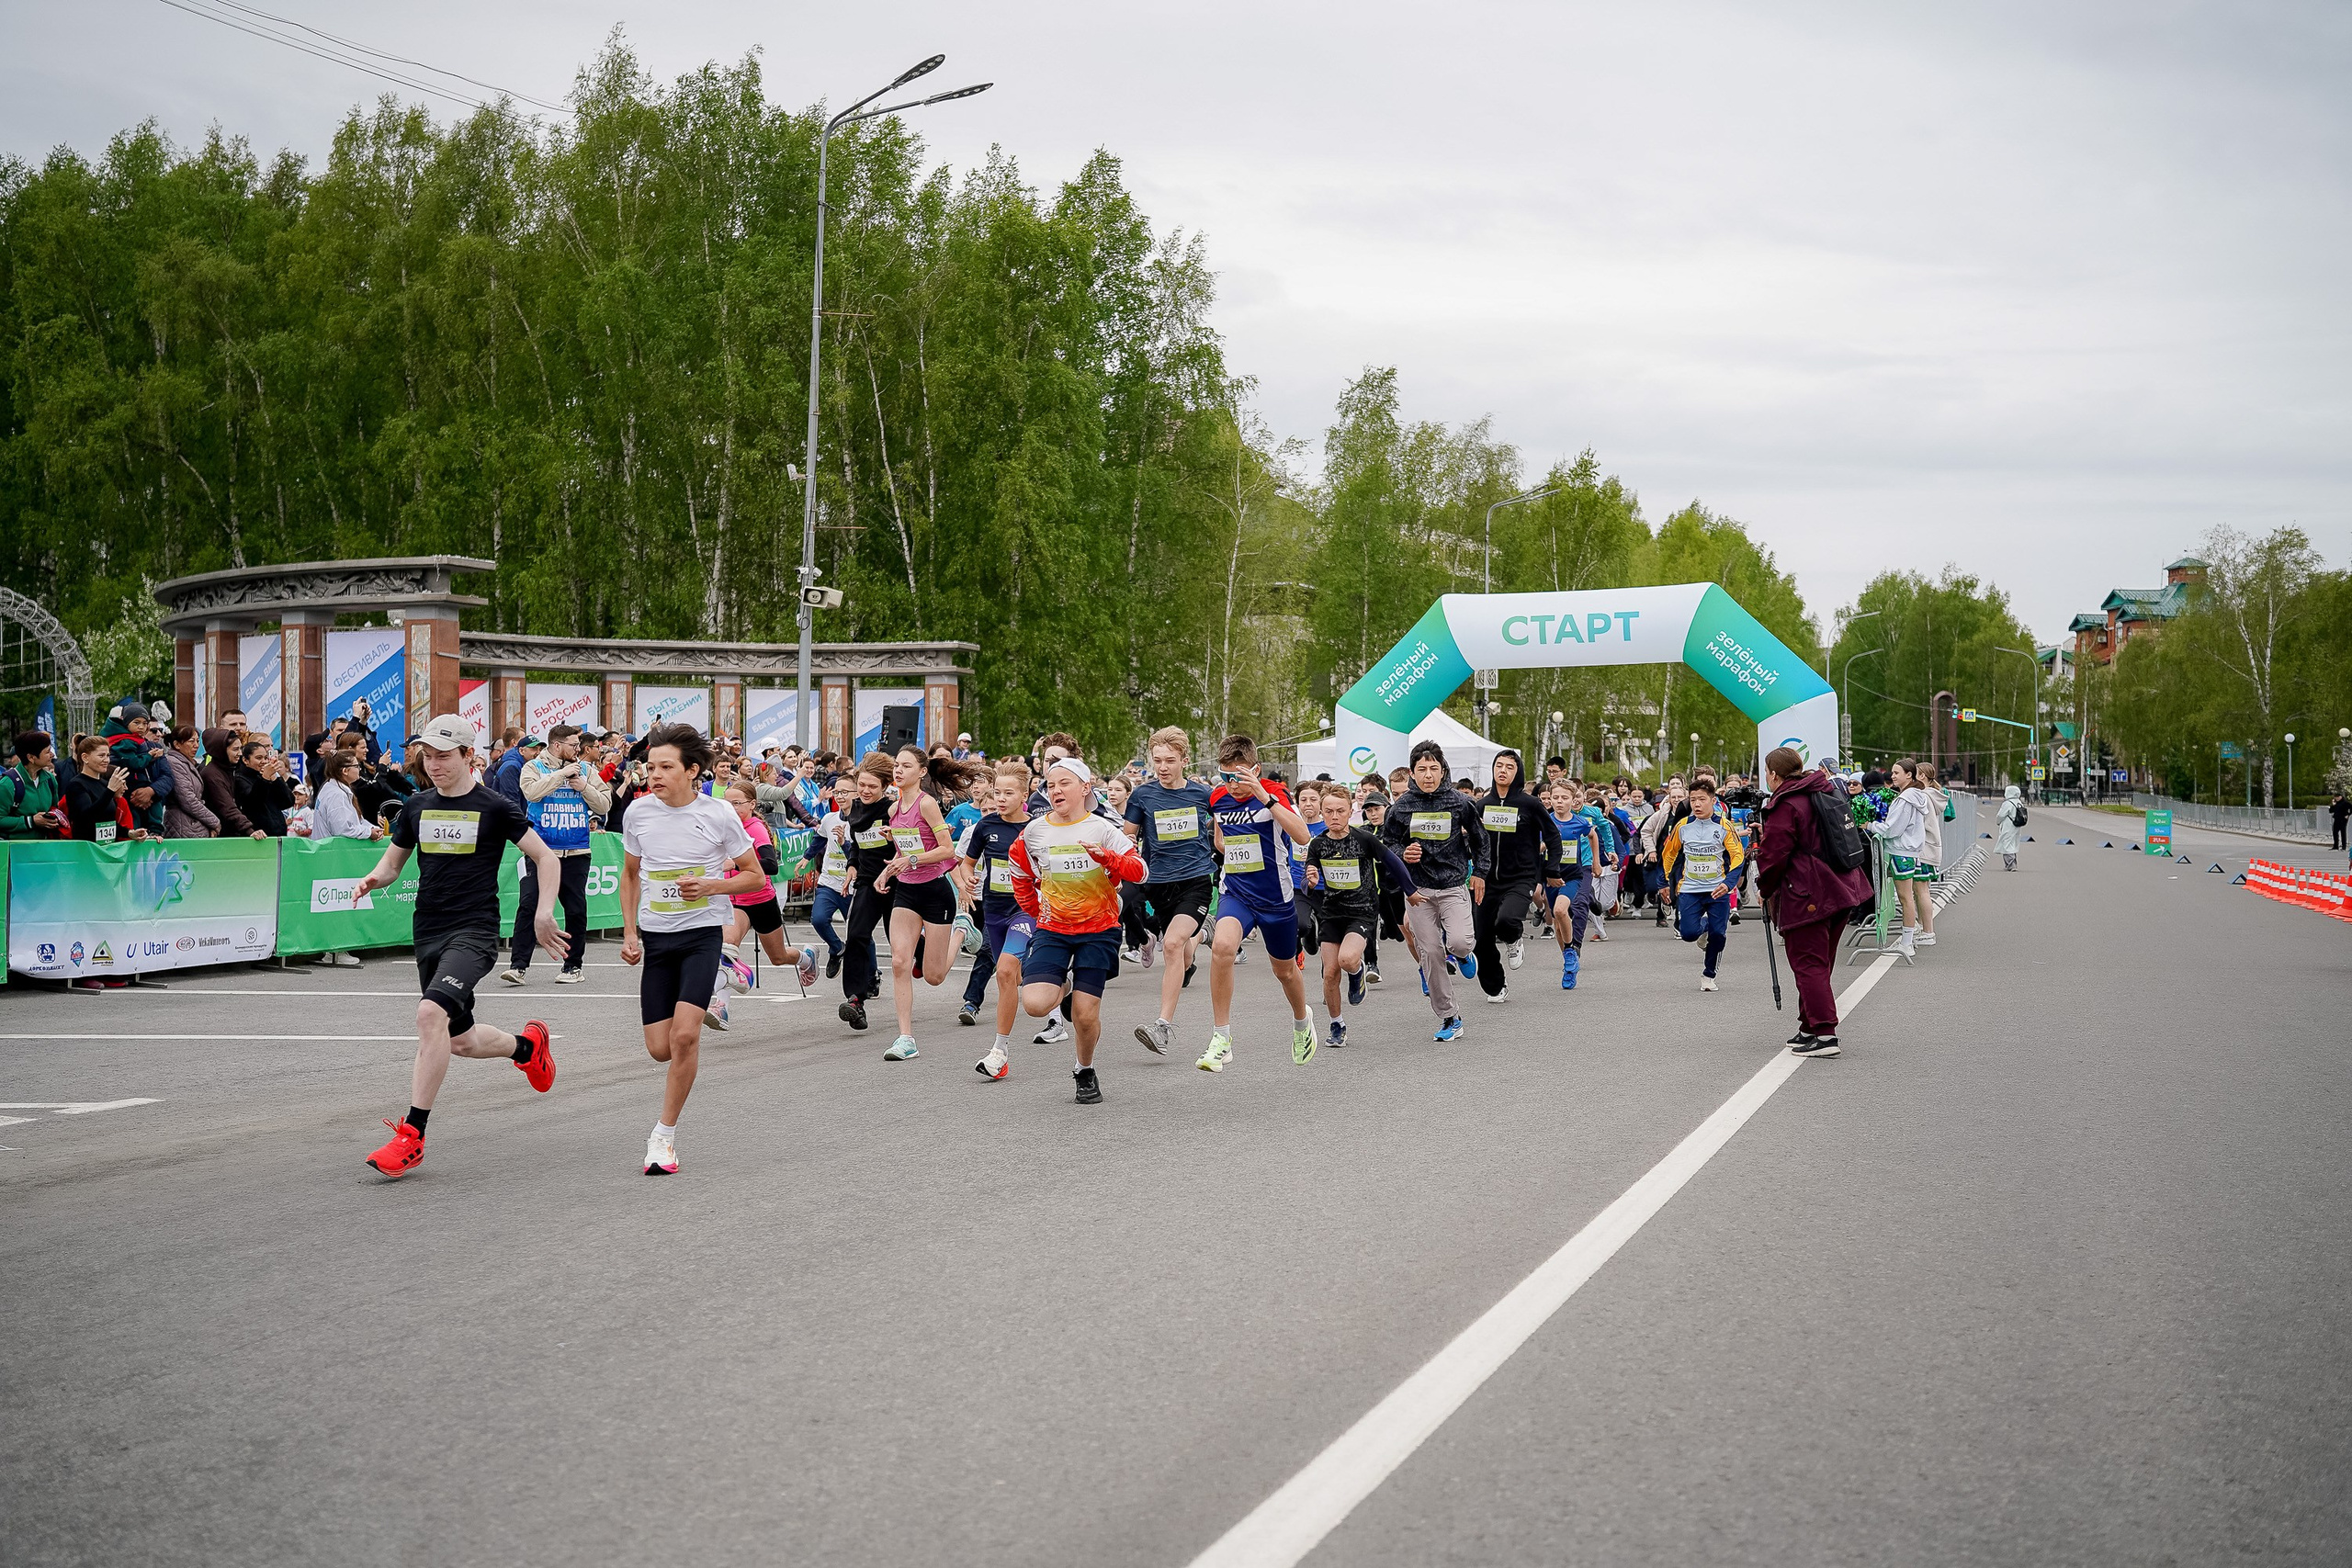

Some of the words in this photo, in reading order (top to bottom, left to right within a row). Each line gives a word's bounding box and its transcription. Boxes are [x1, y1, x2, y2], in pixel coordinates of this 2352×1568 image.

[1501, 611, 1640, 646] СТАРТ
[333, 641, 390, 688] ФЕСТИВАЛЬ
[1715, 630, 1781, 686] зелёный
[1374, 640, 1430, 697] зелёный
[1705, 641, 1767, 696] марафон
[245, 675, 265, 700] БЫТЬ
[1384, 652, 1439, 707] марафон
[260, 693, 277, 716] БЫТЬ
[533, 697, 565, 718] БЫТЬ
[540, 694, 593, 729] РОССИЕЙ
[646, 697, 678, 716] БЫТЬ
[752, 716, 777, 734] БЫТЬ
[776, 703, 797, 720] ВМЕ
[543, 802, 584, 813] ГЛАВНЫЙ
[540, 813, 586, 830] СУДЬЯ
[1167, 820, 1188, 831] 3167
[1491, 816, 1509, 824] 3209
[98, 828, 115, 838] 1341
[434, 828, 461, 840] 3146
[862, 831, 876, 840] 3198
[1063, 859, 1089, 870] 3131
[1228, 851, 1250, 862] 3190
[1329, 872, 1350, 880] 3177
[1011, 925, 1033, 938] adidas
[143, 940, 169, 956] Utair
[442, 976, 464, 990] FILA
